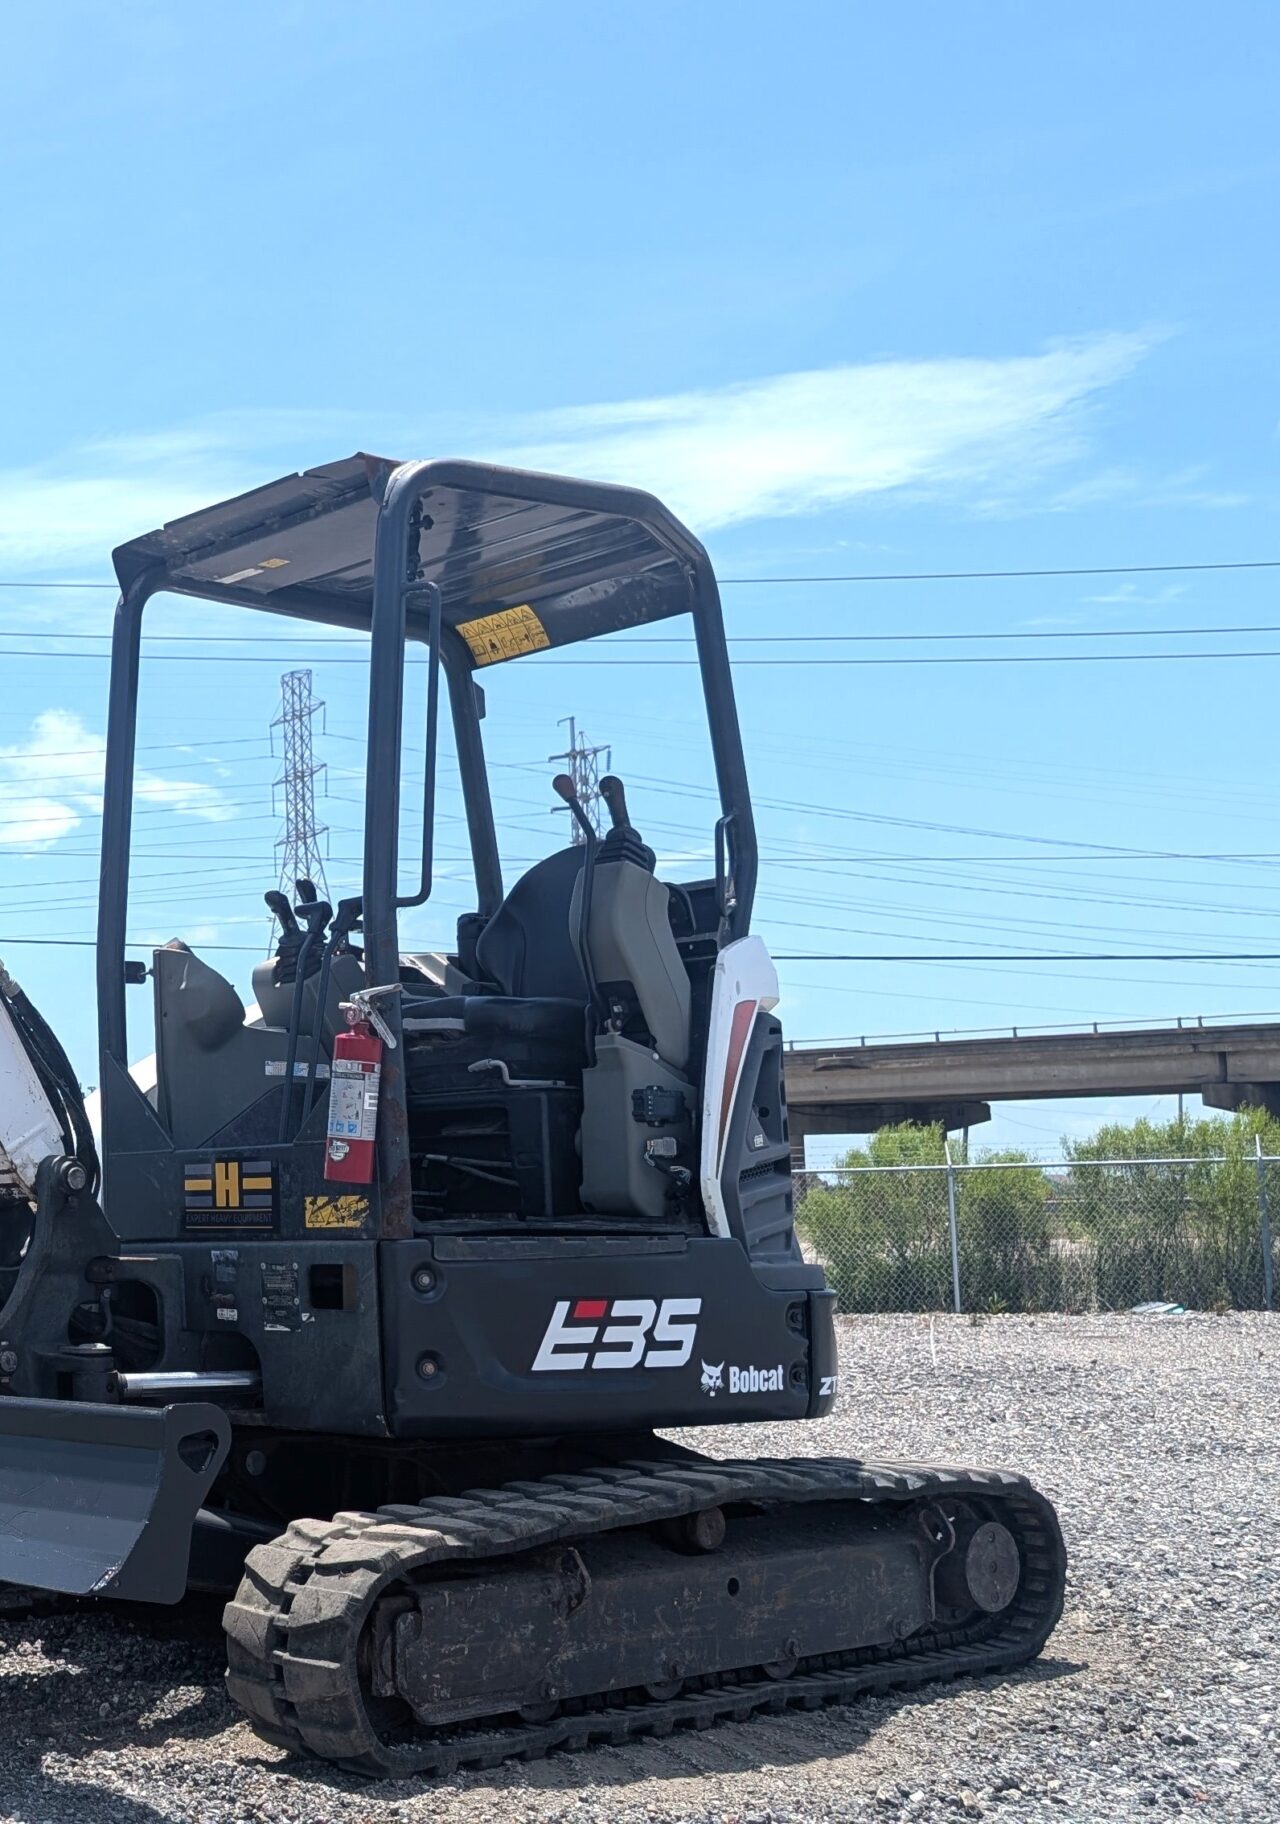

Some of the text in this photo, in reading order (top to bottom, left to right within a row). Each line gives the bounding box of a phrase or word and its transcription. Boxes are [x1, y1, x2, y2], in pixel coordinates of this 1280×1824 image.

[215, 1162, 239, 1207] H
[186, 1213, 272, 1224] EXPERT HEAVY EQUIPMENT
[532, 1298, 702, 1371] E35
[729, 1364, 784, 1393] Bobcat
